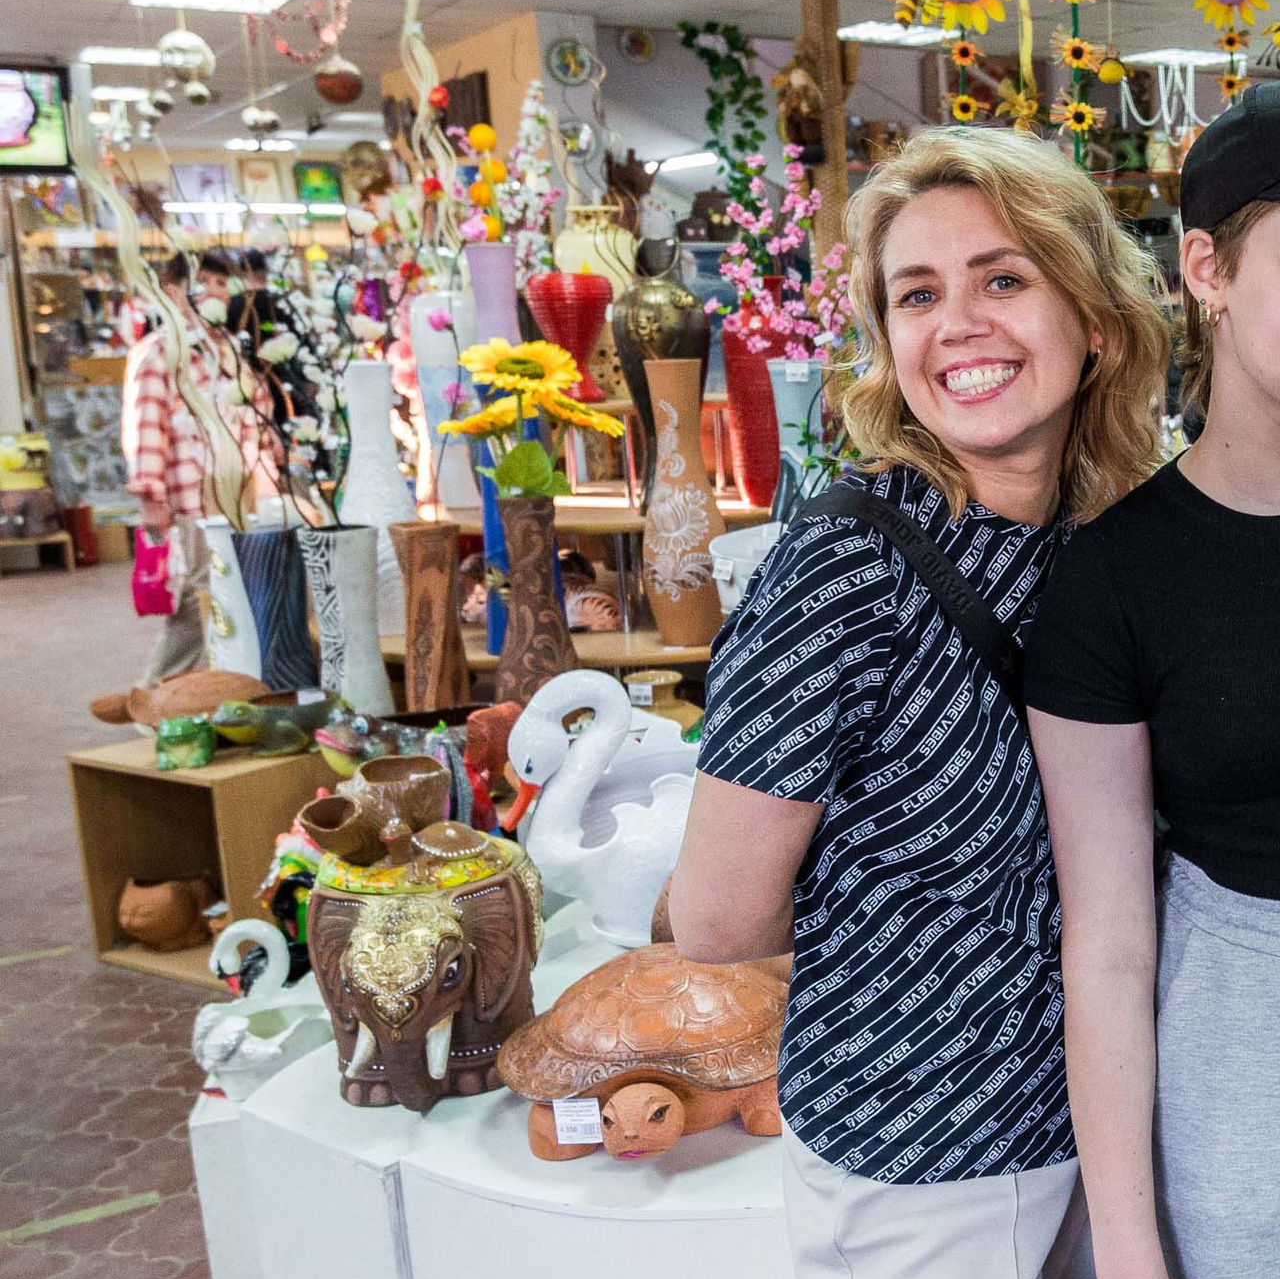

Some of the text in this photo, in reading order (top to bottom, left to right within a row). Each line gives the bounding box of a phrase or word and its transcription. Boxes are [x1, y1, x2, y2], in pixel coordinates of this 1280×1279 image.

[918, 488, 941, 529] EVER
[959, 547, 980, 576] VIBE
[801, 562, 890, 614] FLAME VIBE
[1011, 565, 1039, 599] VIBES
[761, 622, 845, 685] FLAME VIBES
[792, 667, 839, 703] FLAME
[946, 682, 973, 721] LAME
[982, 679, 1000, 714] VIBE
[899, 686, 932, 726] VIBES
[728, 713, 774, 754] CLEVER
[766, 729, 808, 765] FLAME
[920, 719, 952, 756] VIBES
[783, 755, 829, 794] FLAME
[863, 761, 909, 793] CLEVER
[902, 747, 972, 814] FLAME VIBES
[978, 741, 1006, 794] CLEVER
[1015, 747, 1033, 785] FLAM
[879, 822, 949, 863] FLAME VIBES
[952, 815, 1003, 863] CLEVER
[862, 882, 894, 914] VIBES
[948, 867, 990, 901] FLAME
[794, 907, 829, 934] LEVER
[868, 915, 906, 954] CLEVER
[907, 923, 944, 961] FLAME
[940, 904, 969, 927] VIBE
[954, 926, 988, 957] VIBES
[852, 975, 890, 1010] FLAME
[897, 973, 940, 1014] CLEVER
[936, 956, 1002, 1023] FLAME VIBES
[1002, 953, 1043, 1001] CLEVER
[863, 1041, 912, 1082] CLEVER
[939, 1025, 977, 1061] FLAME
[813, 1085, 849, 1113] CLEVER
[950, 1055, 1022, 1124] FLAME VIBES
[880, 1080, 954, 1142] FLAME VIBES
[876, 1144, 925, 1184] CLEVER
[925, 1145, 965, 1183] FLAME
[974, 1139, 1008, 1172] VIBES
